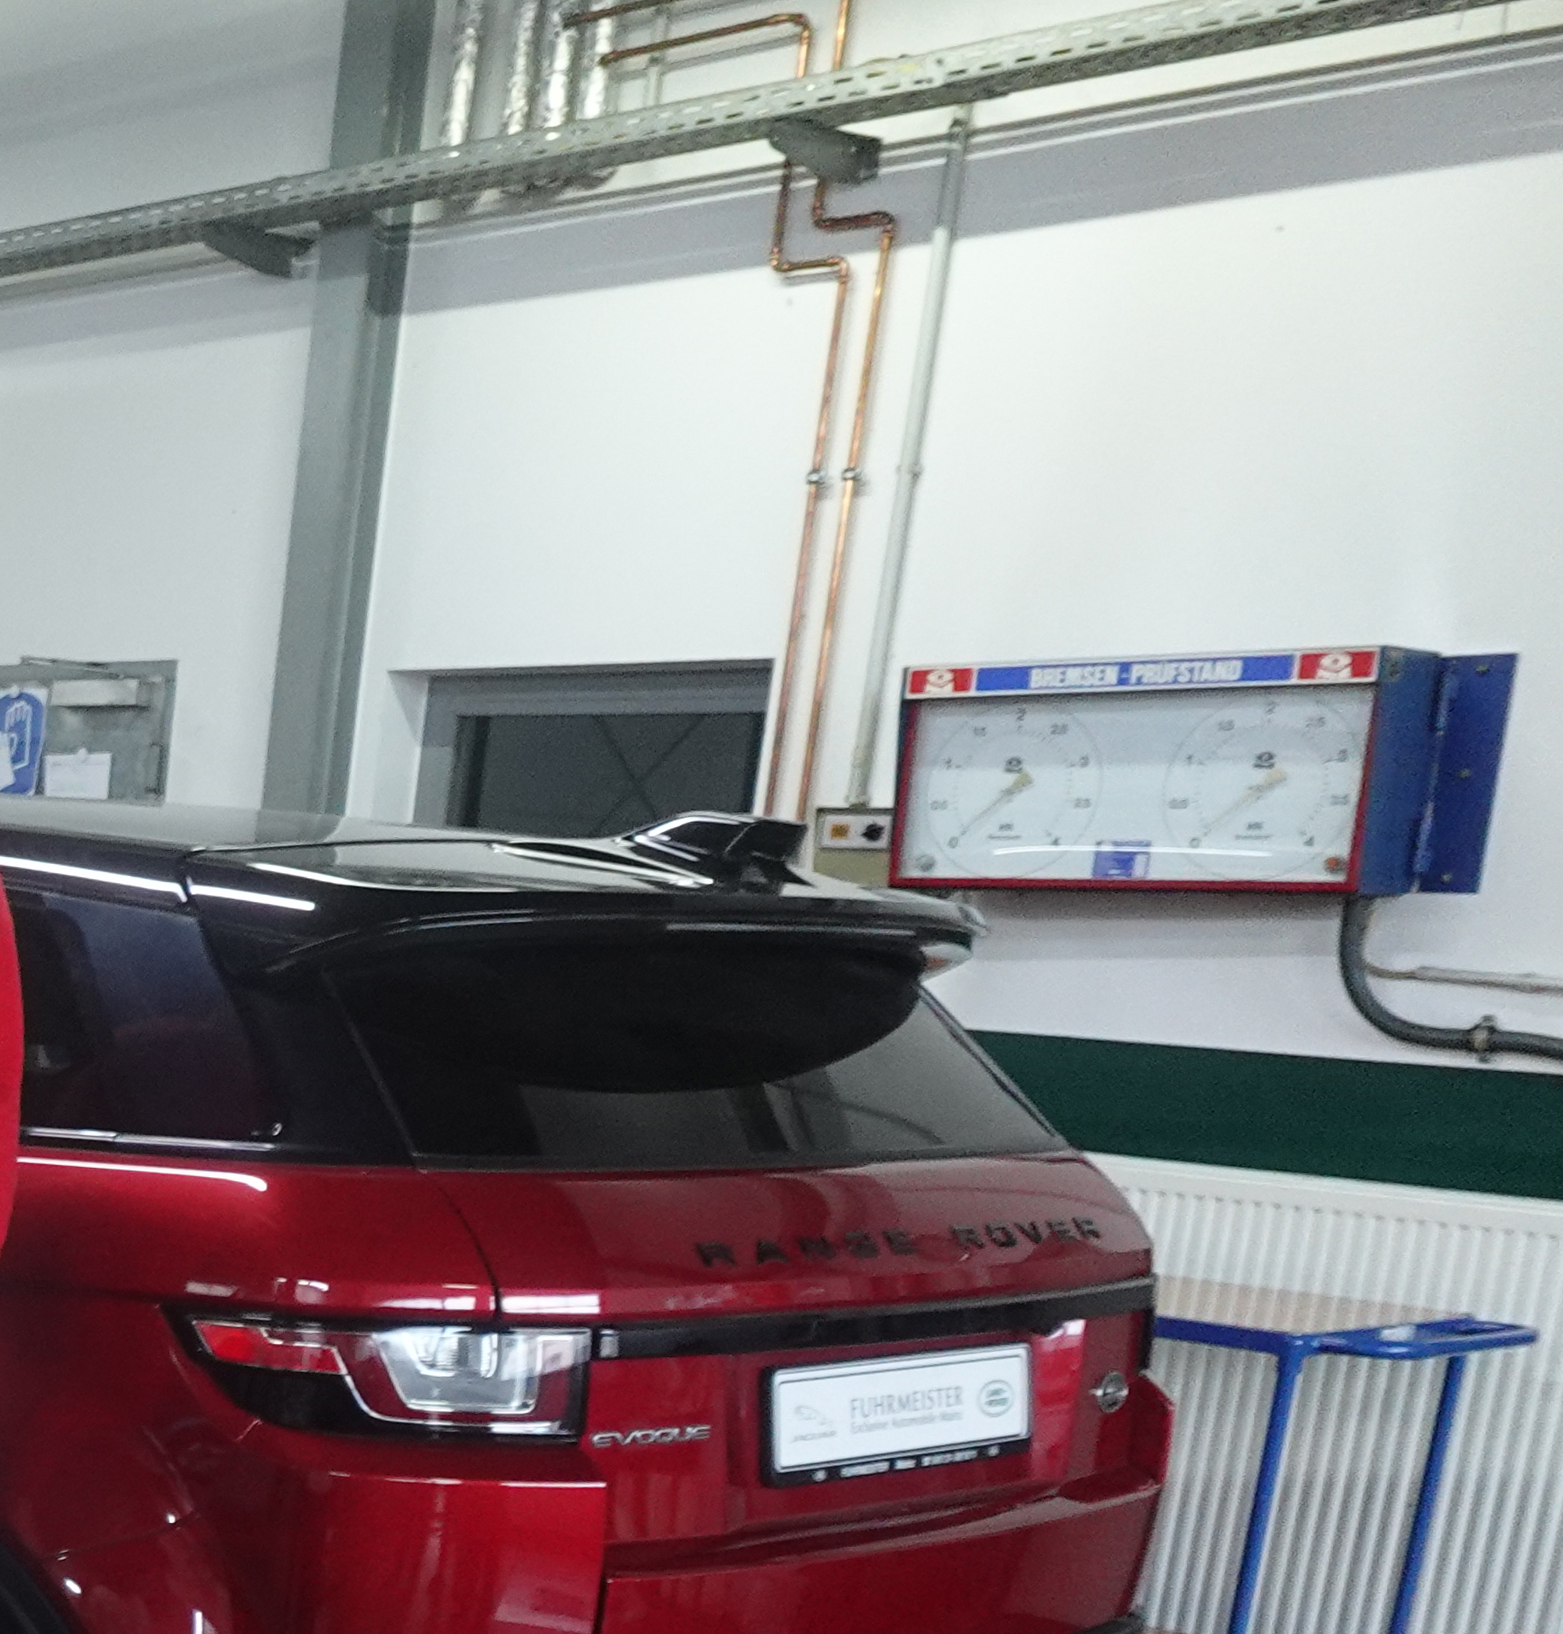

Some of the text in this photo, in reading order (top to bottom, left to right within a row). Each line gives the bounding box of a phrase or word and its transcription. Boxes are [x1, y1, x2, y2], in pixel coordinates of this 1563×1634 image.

[695, 1216, 1102, 1267] RANGE ROVER
[850, 1386, 963, 1419] FUHRMEISTER
[591, 1425, 712, 1448] EVOQUE
